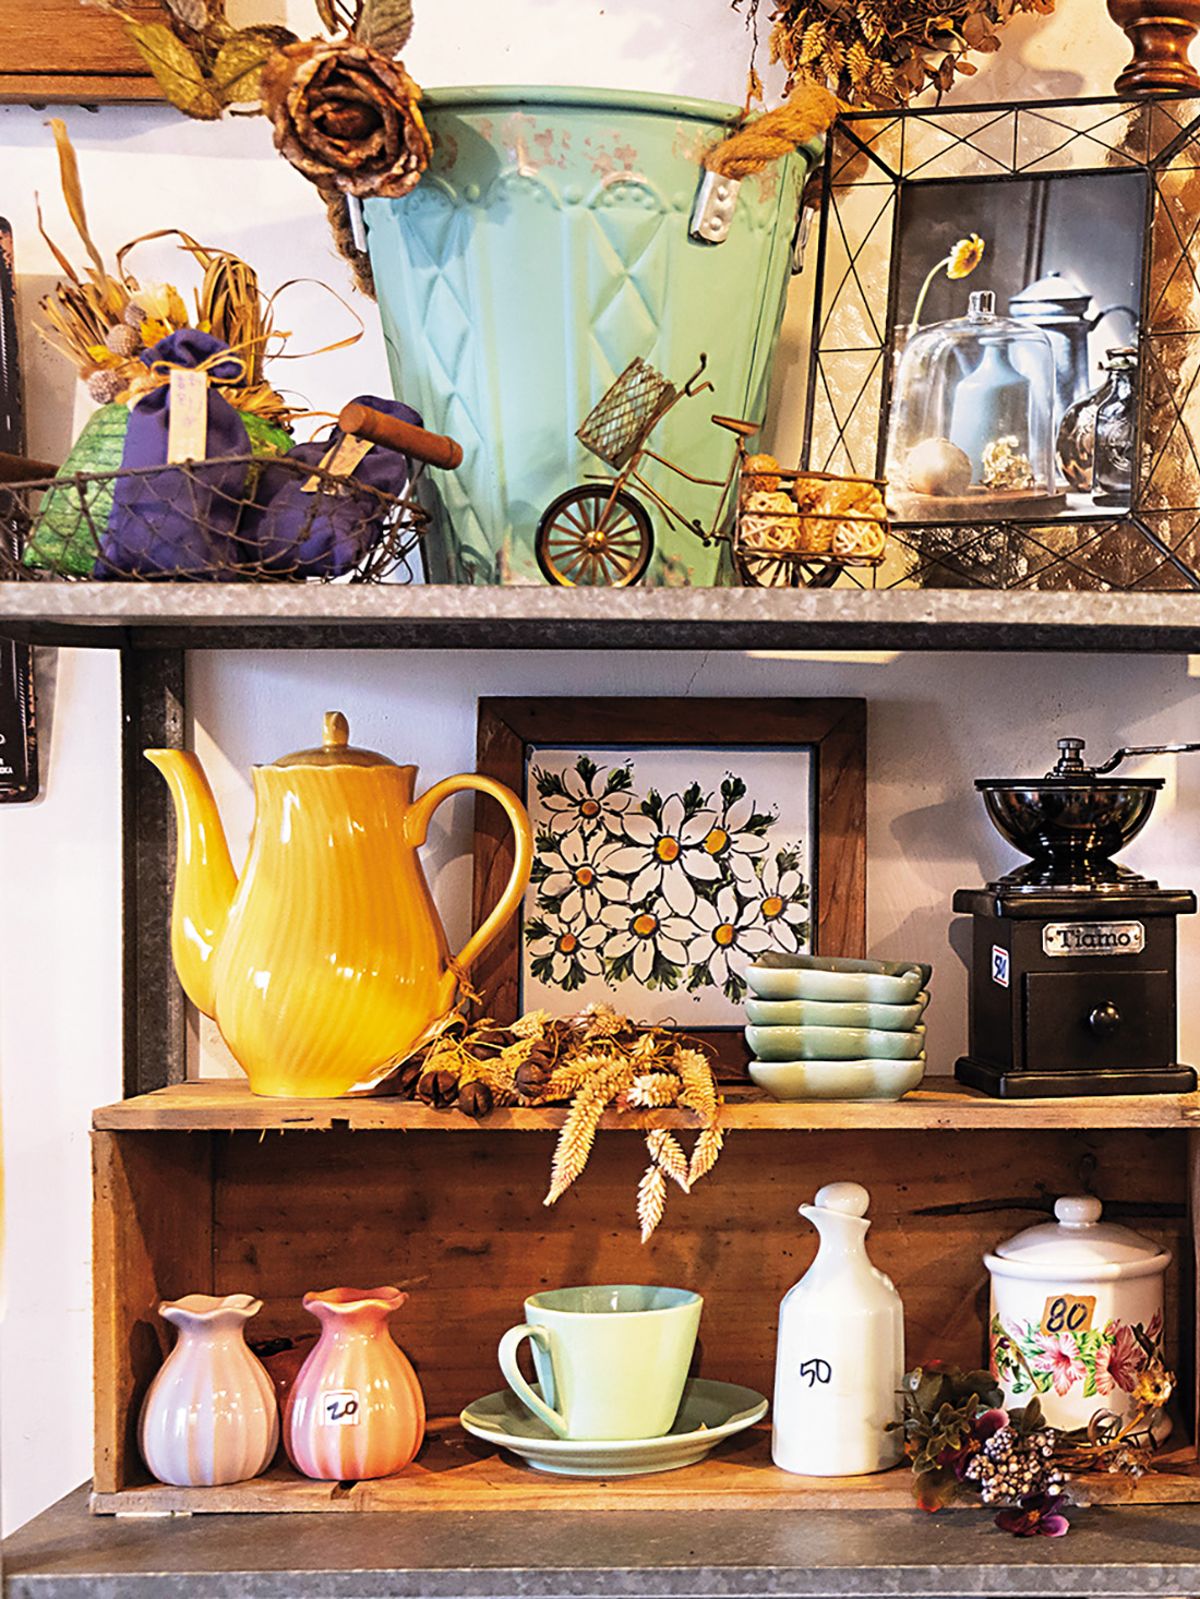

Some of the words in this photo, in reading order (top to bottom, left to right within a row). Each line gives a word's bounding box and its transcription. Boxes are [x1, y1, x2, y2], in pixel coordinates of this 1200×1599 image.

[1057, 929, 1131, 948] Tiamo
[1046, 1298, 1088, 1332] 80
[800, 1358, 832, 1388] 50
